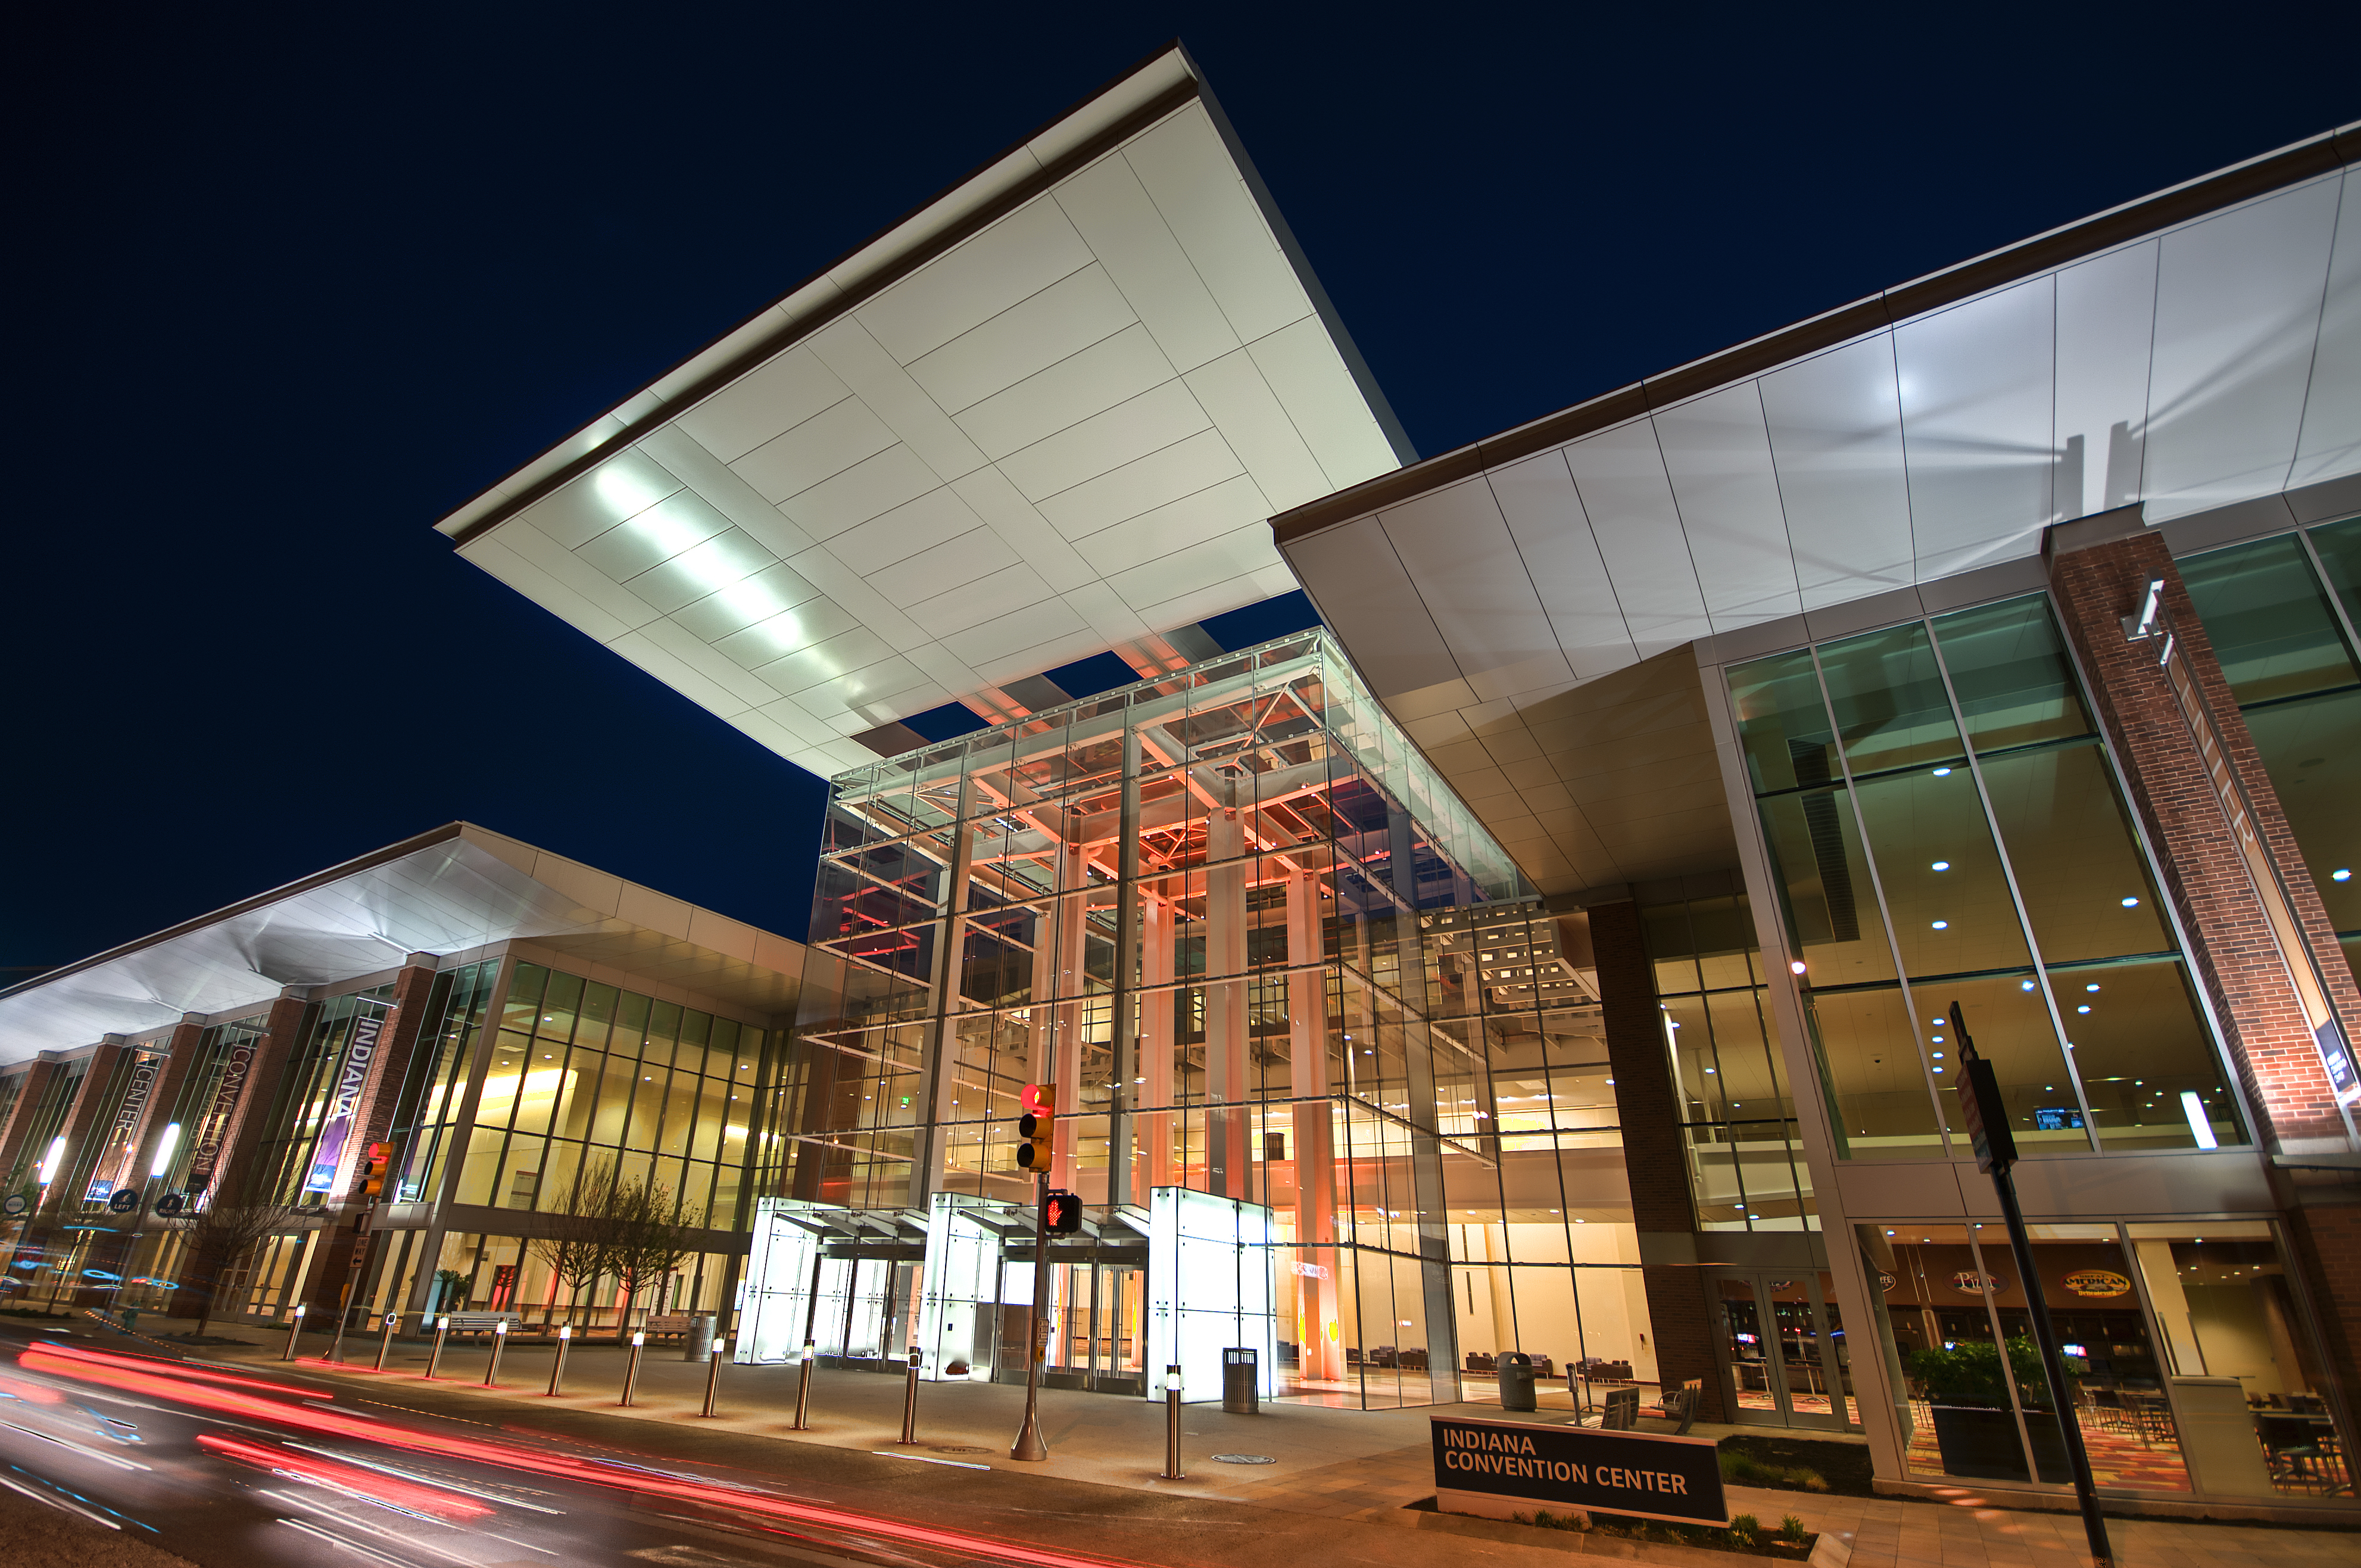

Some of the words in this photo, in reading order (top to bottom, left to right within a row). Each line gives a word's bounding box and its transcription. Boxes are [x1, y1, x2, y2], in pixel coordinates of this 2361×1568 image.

[115, 1068, 154, 1130] CENTER
[330, 1021, 379, 1118] INDIANA
[197, 1049, 251, 1171] CONVENTION
[1443, 1429, 1537, 1456] INDIANA
[1445, 1450, 1589, 1484] CONVENTION
[1595, 1466, 1688, 1495] CENTER
